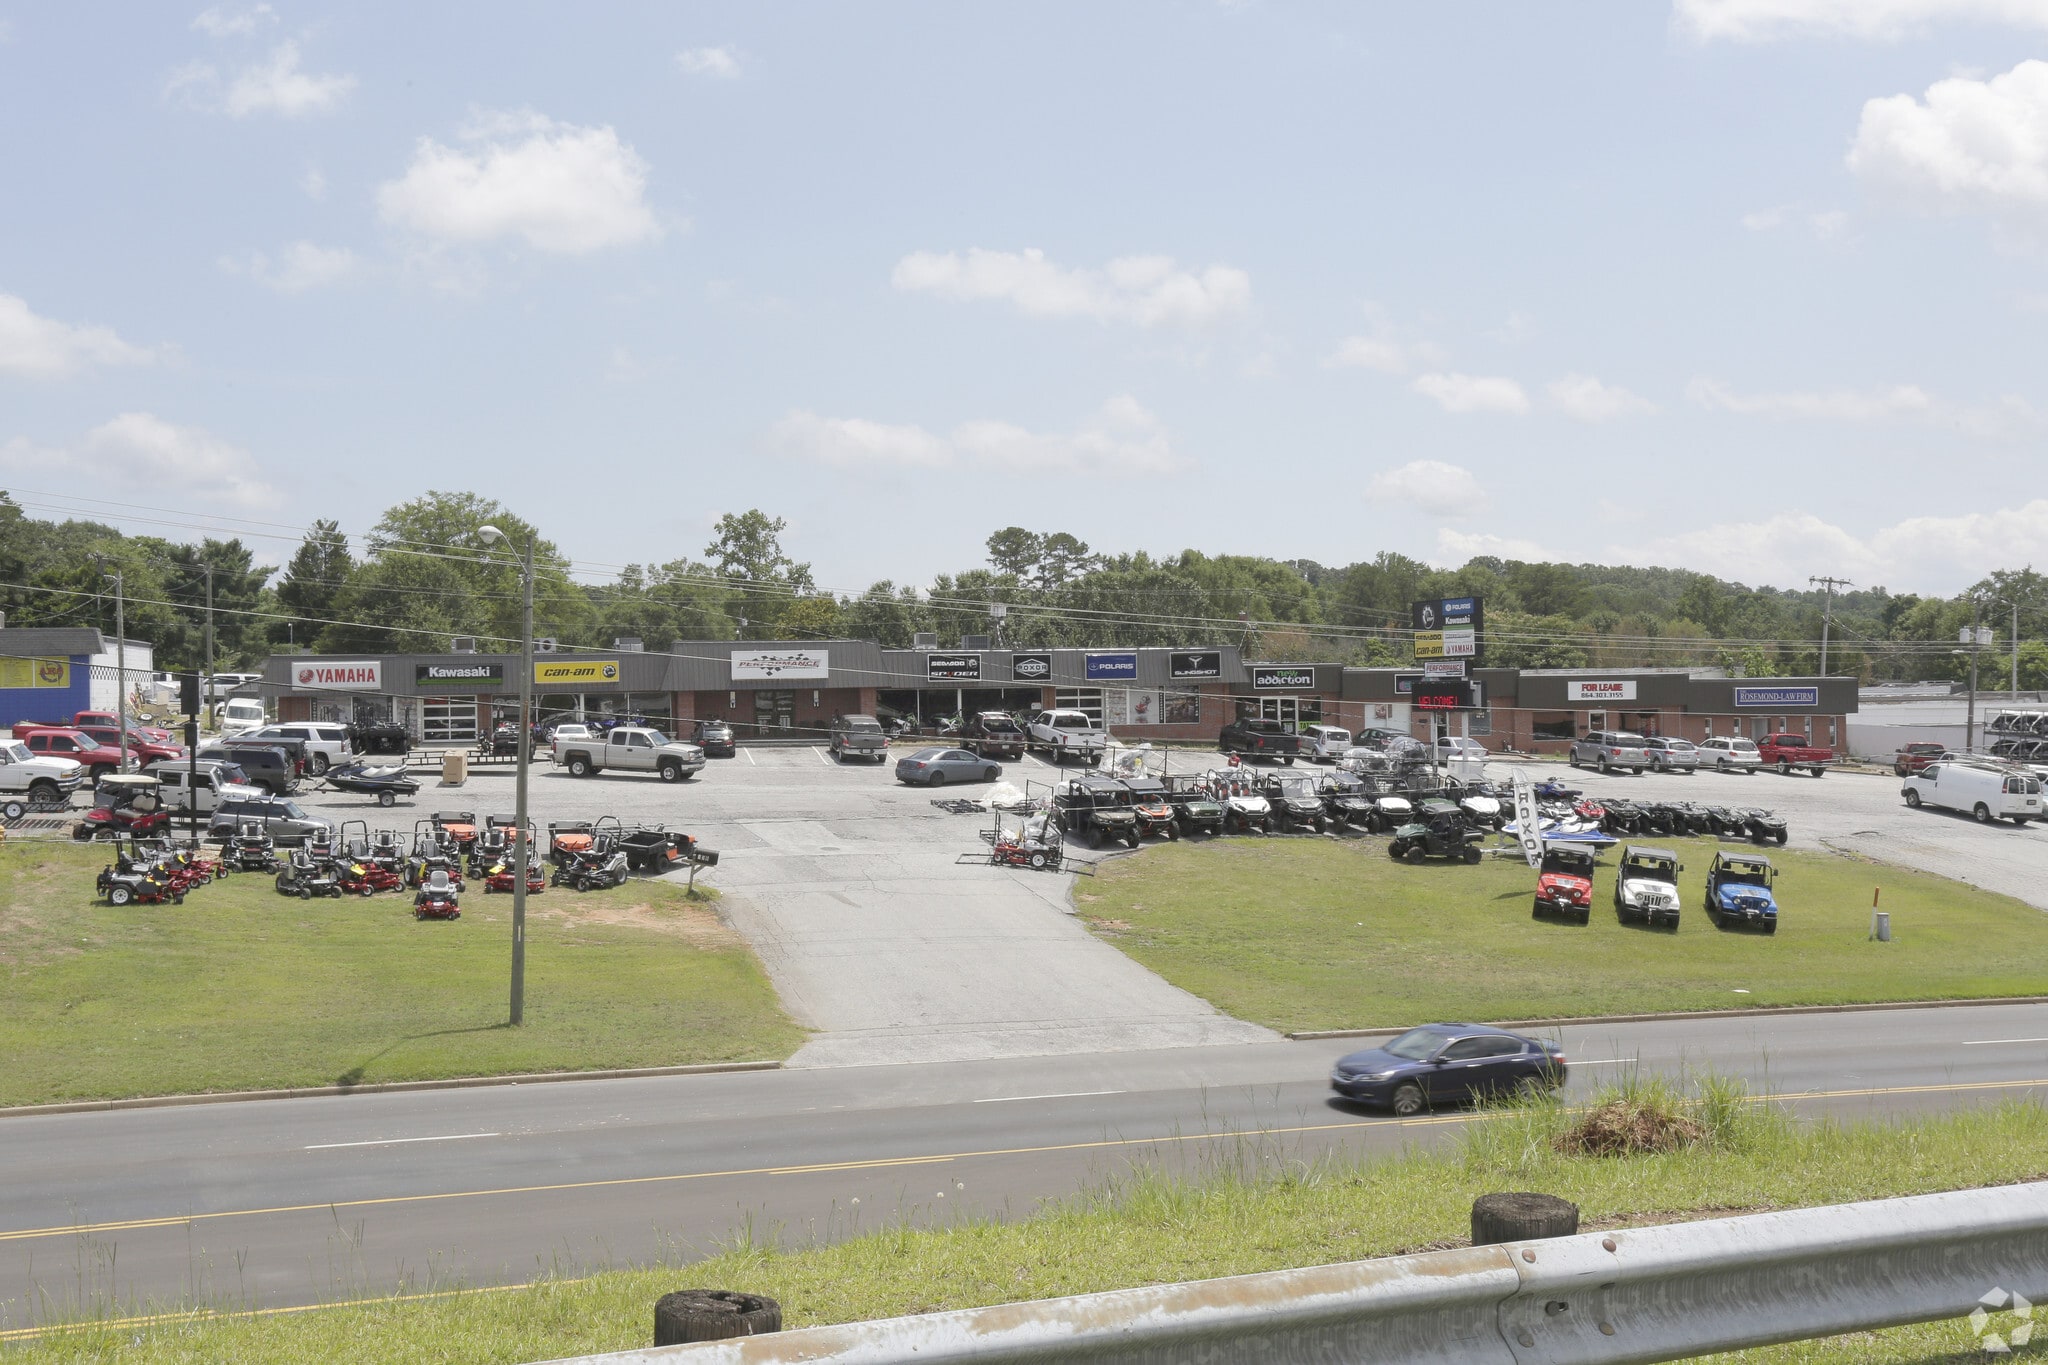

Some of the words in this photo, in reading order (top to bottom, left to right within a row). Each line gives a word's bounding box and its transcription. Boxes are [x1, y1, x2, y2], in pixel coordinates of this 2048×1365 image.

[1445, 614, 1470, 624] Kawasaki
[1416, 646, 1442, 654] can-am
[1452, 644, 1474, 653] YAMAHA
[428, 666, 490, 678] Kawasaki
[544, 668, 596, 676] can-am
[1426, 664, 1463, 672] PERFORMANCE
[316, 668, 376, 682] YAMAHA
[1257, 675, 1310, 684] addiction
[1582, 684, 1598, 692] FOR
[1599, 684, 1623, 692] LEASE
[1796, 692, 1813, 700] FIRM
[1418, 696, 1458, 708] WELCOME!
